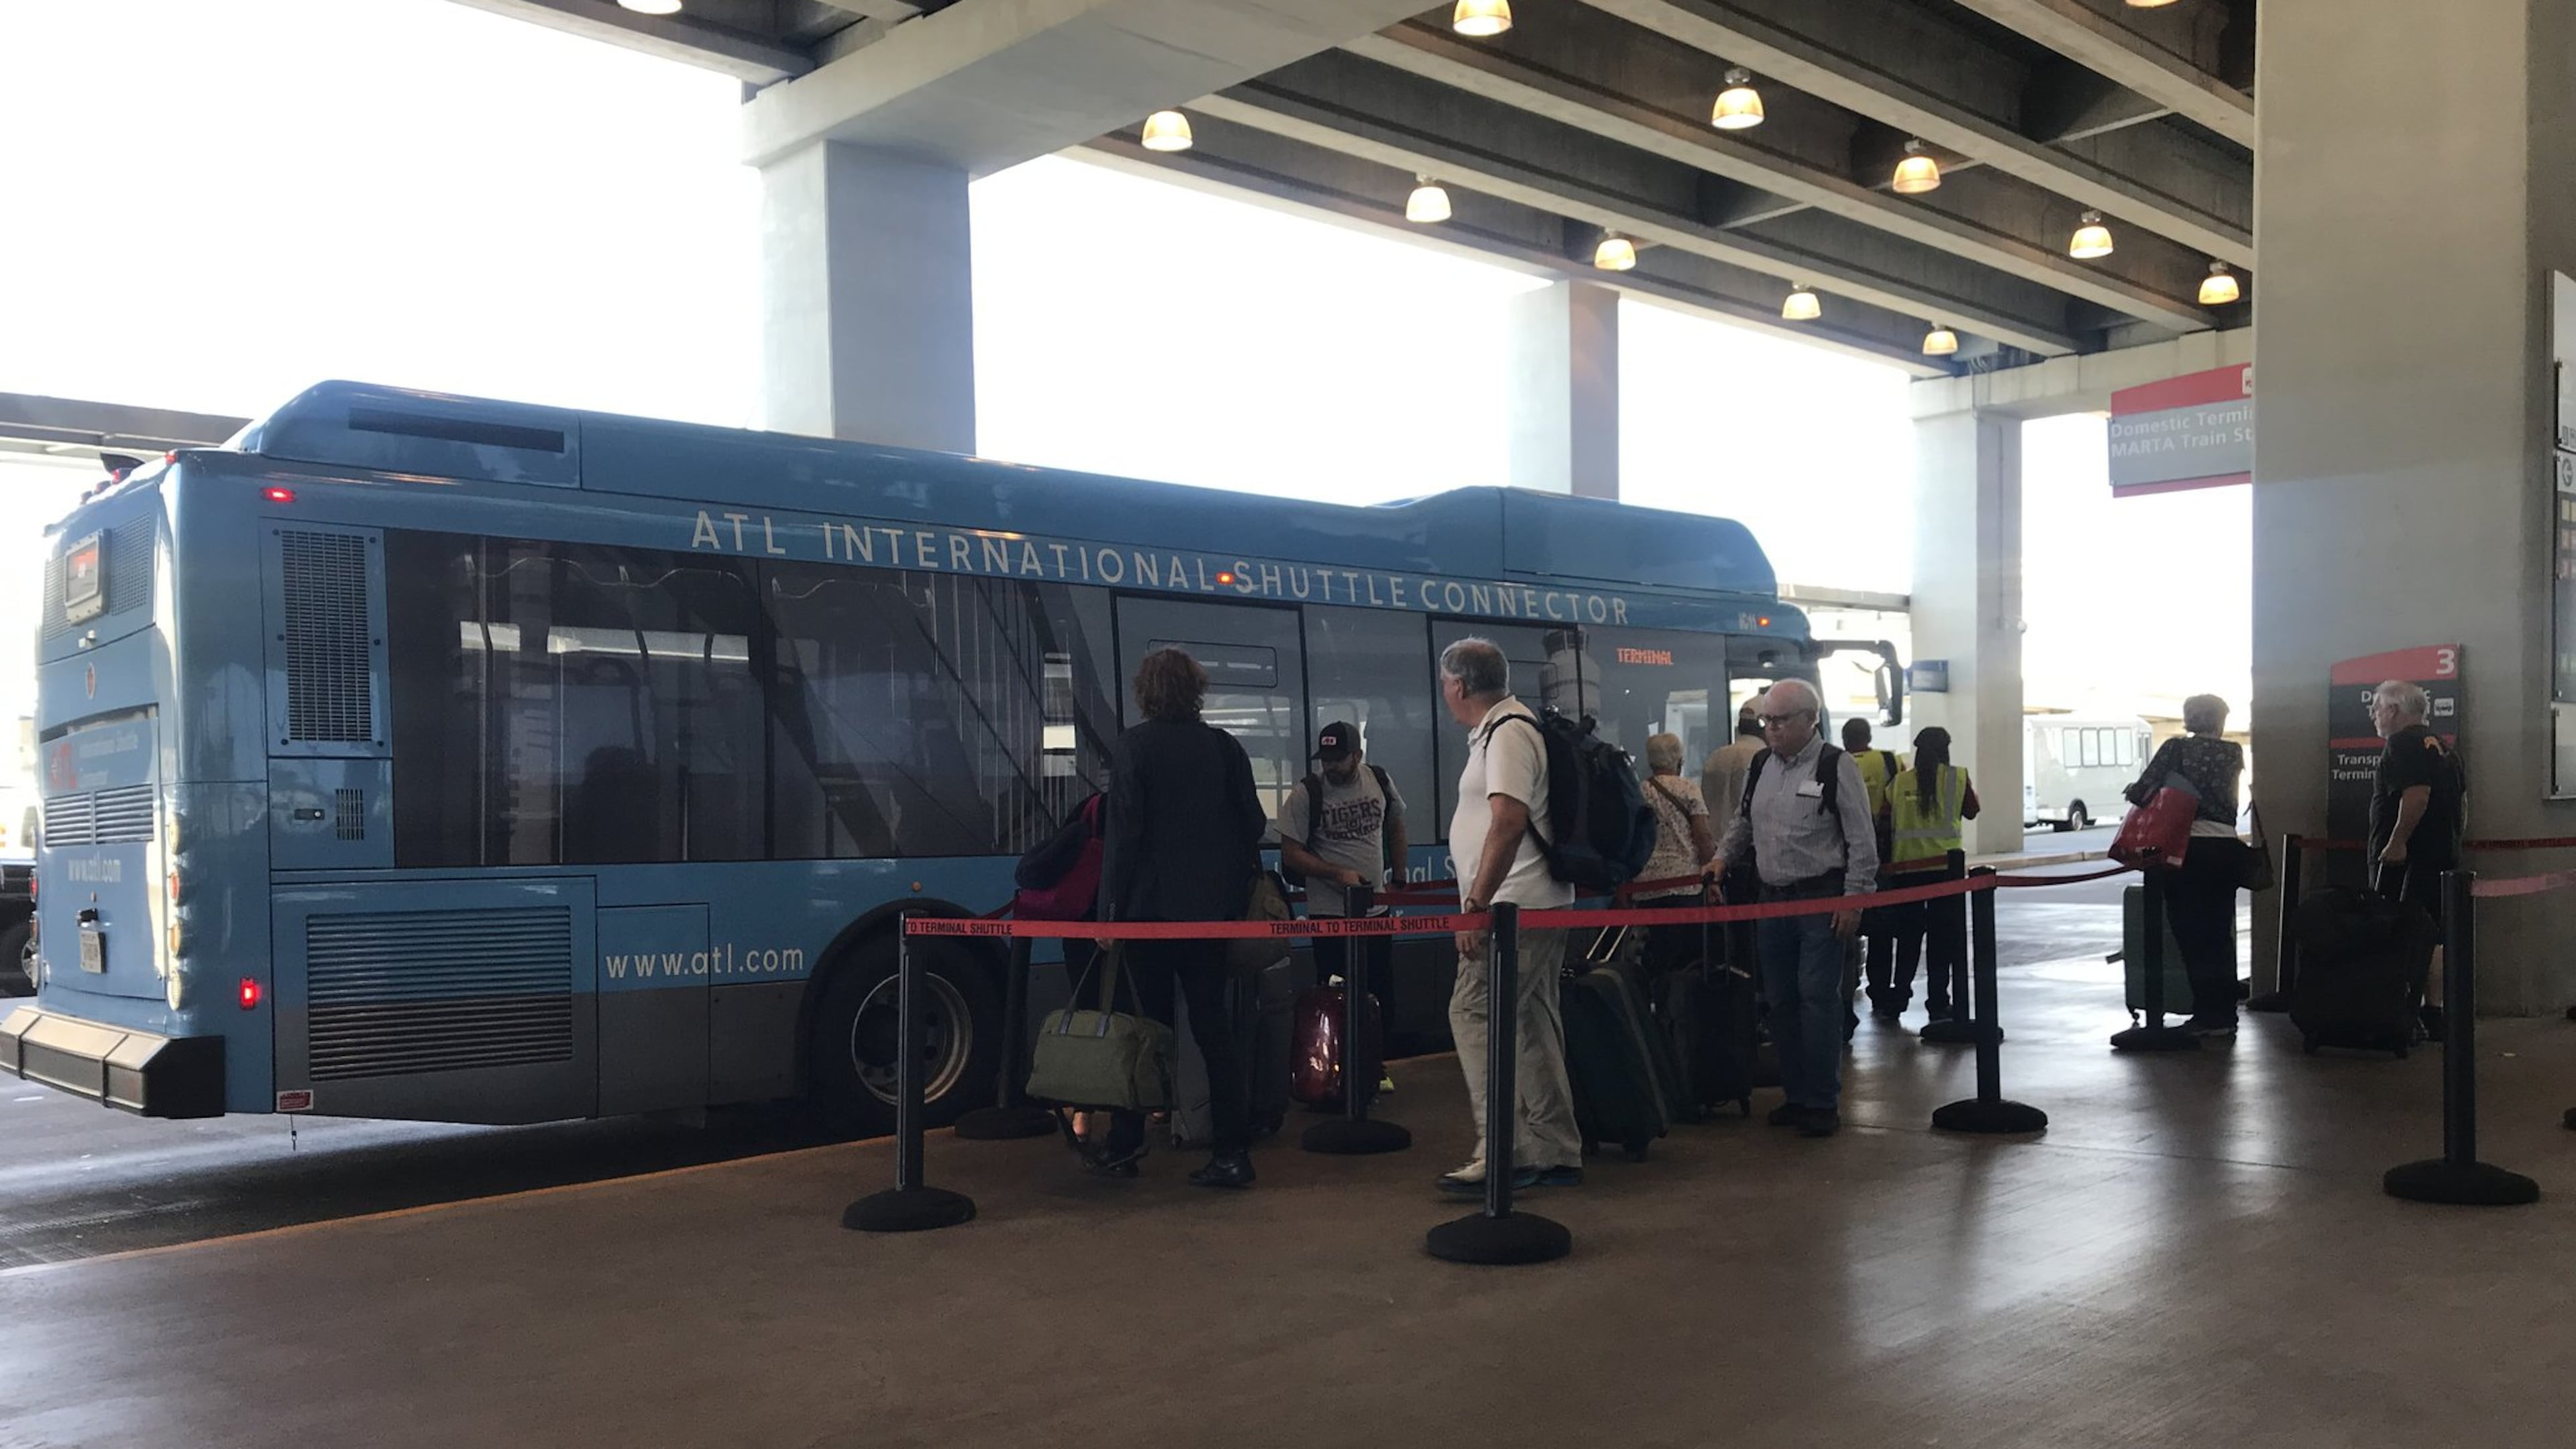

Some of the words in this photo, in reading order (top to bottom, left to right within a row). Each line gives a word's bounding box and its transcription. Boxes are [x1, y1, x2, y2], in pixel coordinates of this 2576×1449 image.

[2112, 417, 2190, 437] Domestic
[2112, 437, 2174, 458] MARTA
[2182, 430, 2226, 448] Train
[691, 510, 786, 555] ATL
[823, 522, 1214, 592] INTERNATIONAL
[1233, 561, 1407, 605] SHUTTLE
[1420, 579, 1629, 625] CONNECTOR
[1615, 647, 1674, 665] TERMINAL
[2436, 649, 2455, 675] 3
[1322, 798, 1382, 828] TIGERS
[920, 921, 967, 934] TERMINAL
[970, 922, 1012, 934] SHUTTLE
[1269, 921, 1323, 934] TERMINAL
[1327, 921, 1340, 933] TO
[1343, 919, 1397, 933] TERMINAL
[1400, 916, 1450, 930] SHUTTLE
[605, 943, 804, 979] www.atl.com
